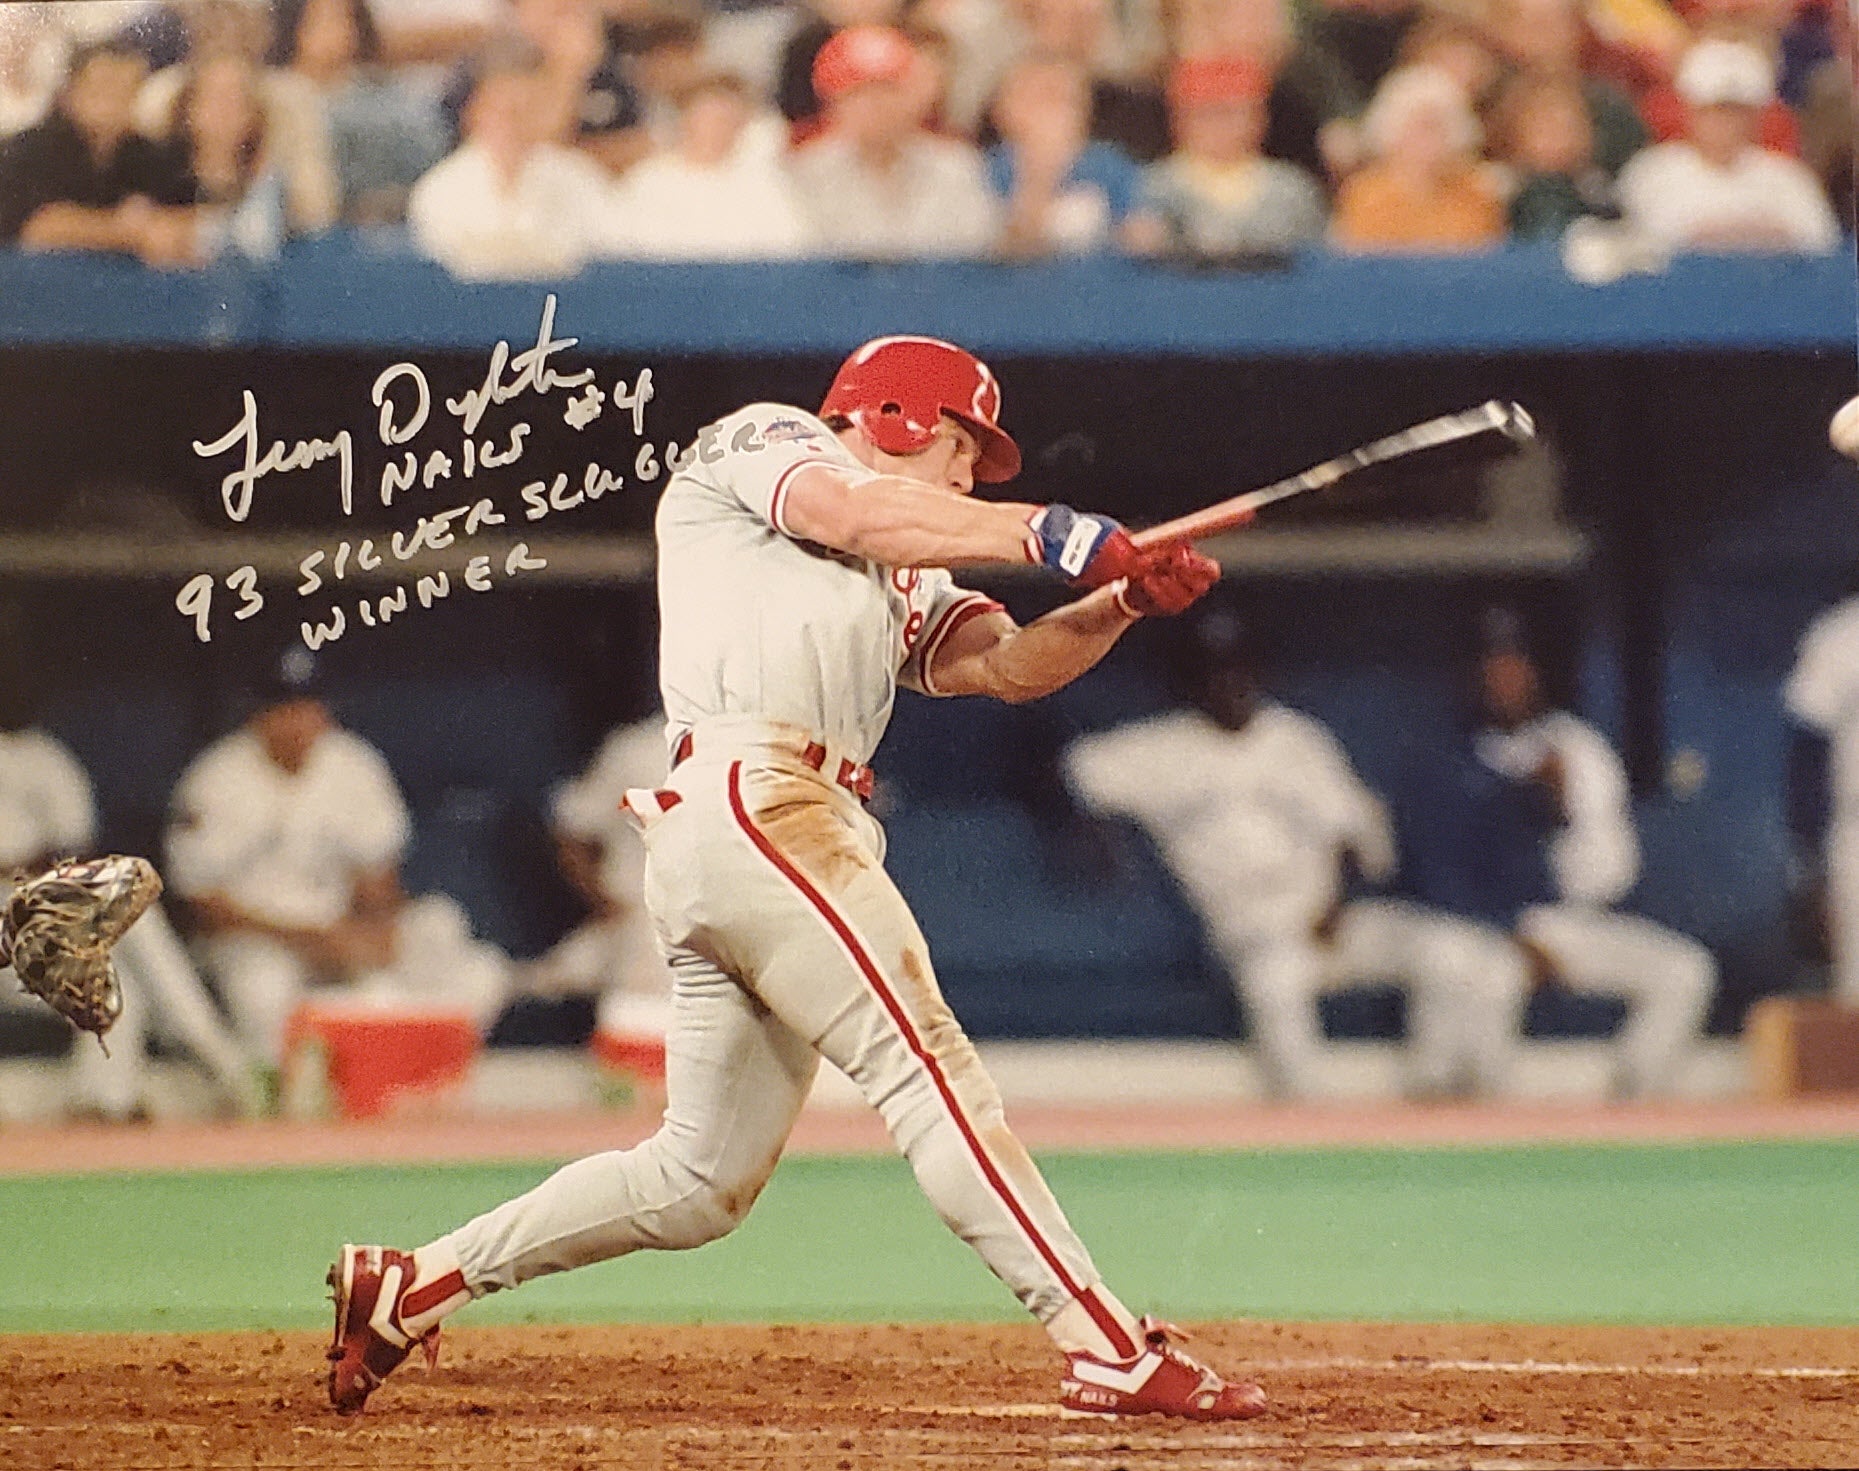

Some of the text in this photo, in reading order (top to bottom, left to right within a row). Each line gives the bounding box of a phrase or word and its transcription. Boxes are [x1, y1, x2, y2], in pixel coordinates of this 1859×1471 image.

[175, 565, 264, 642] 93
[298, 497, 506, 596] SILVER
[300, 542, 548, 650] WINNER
